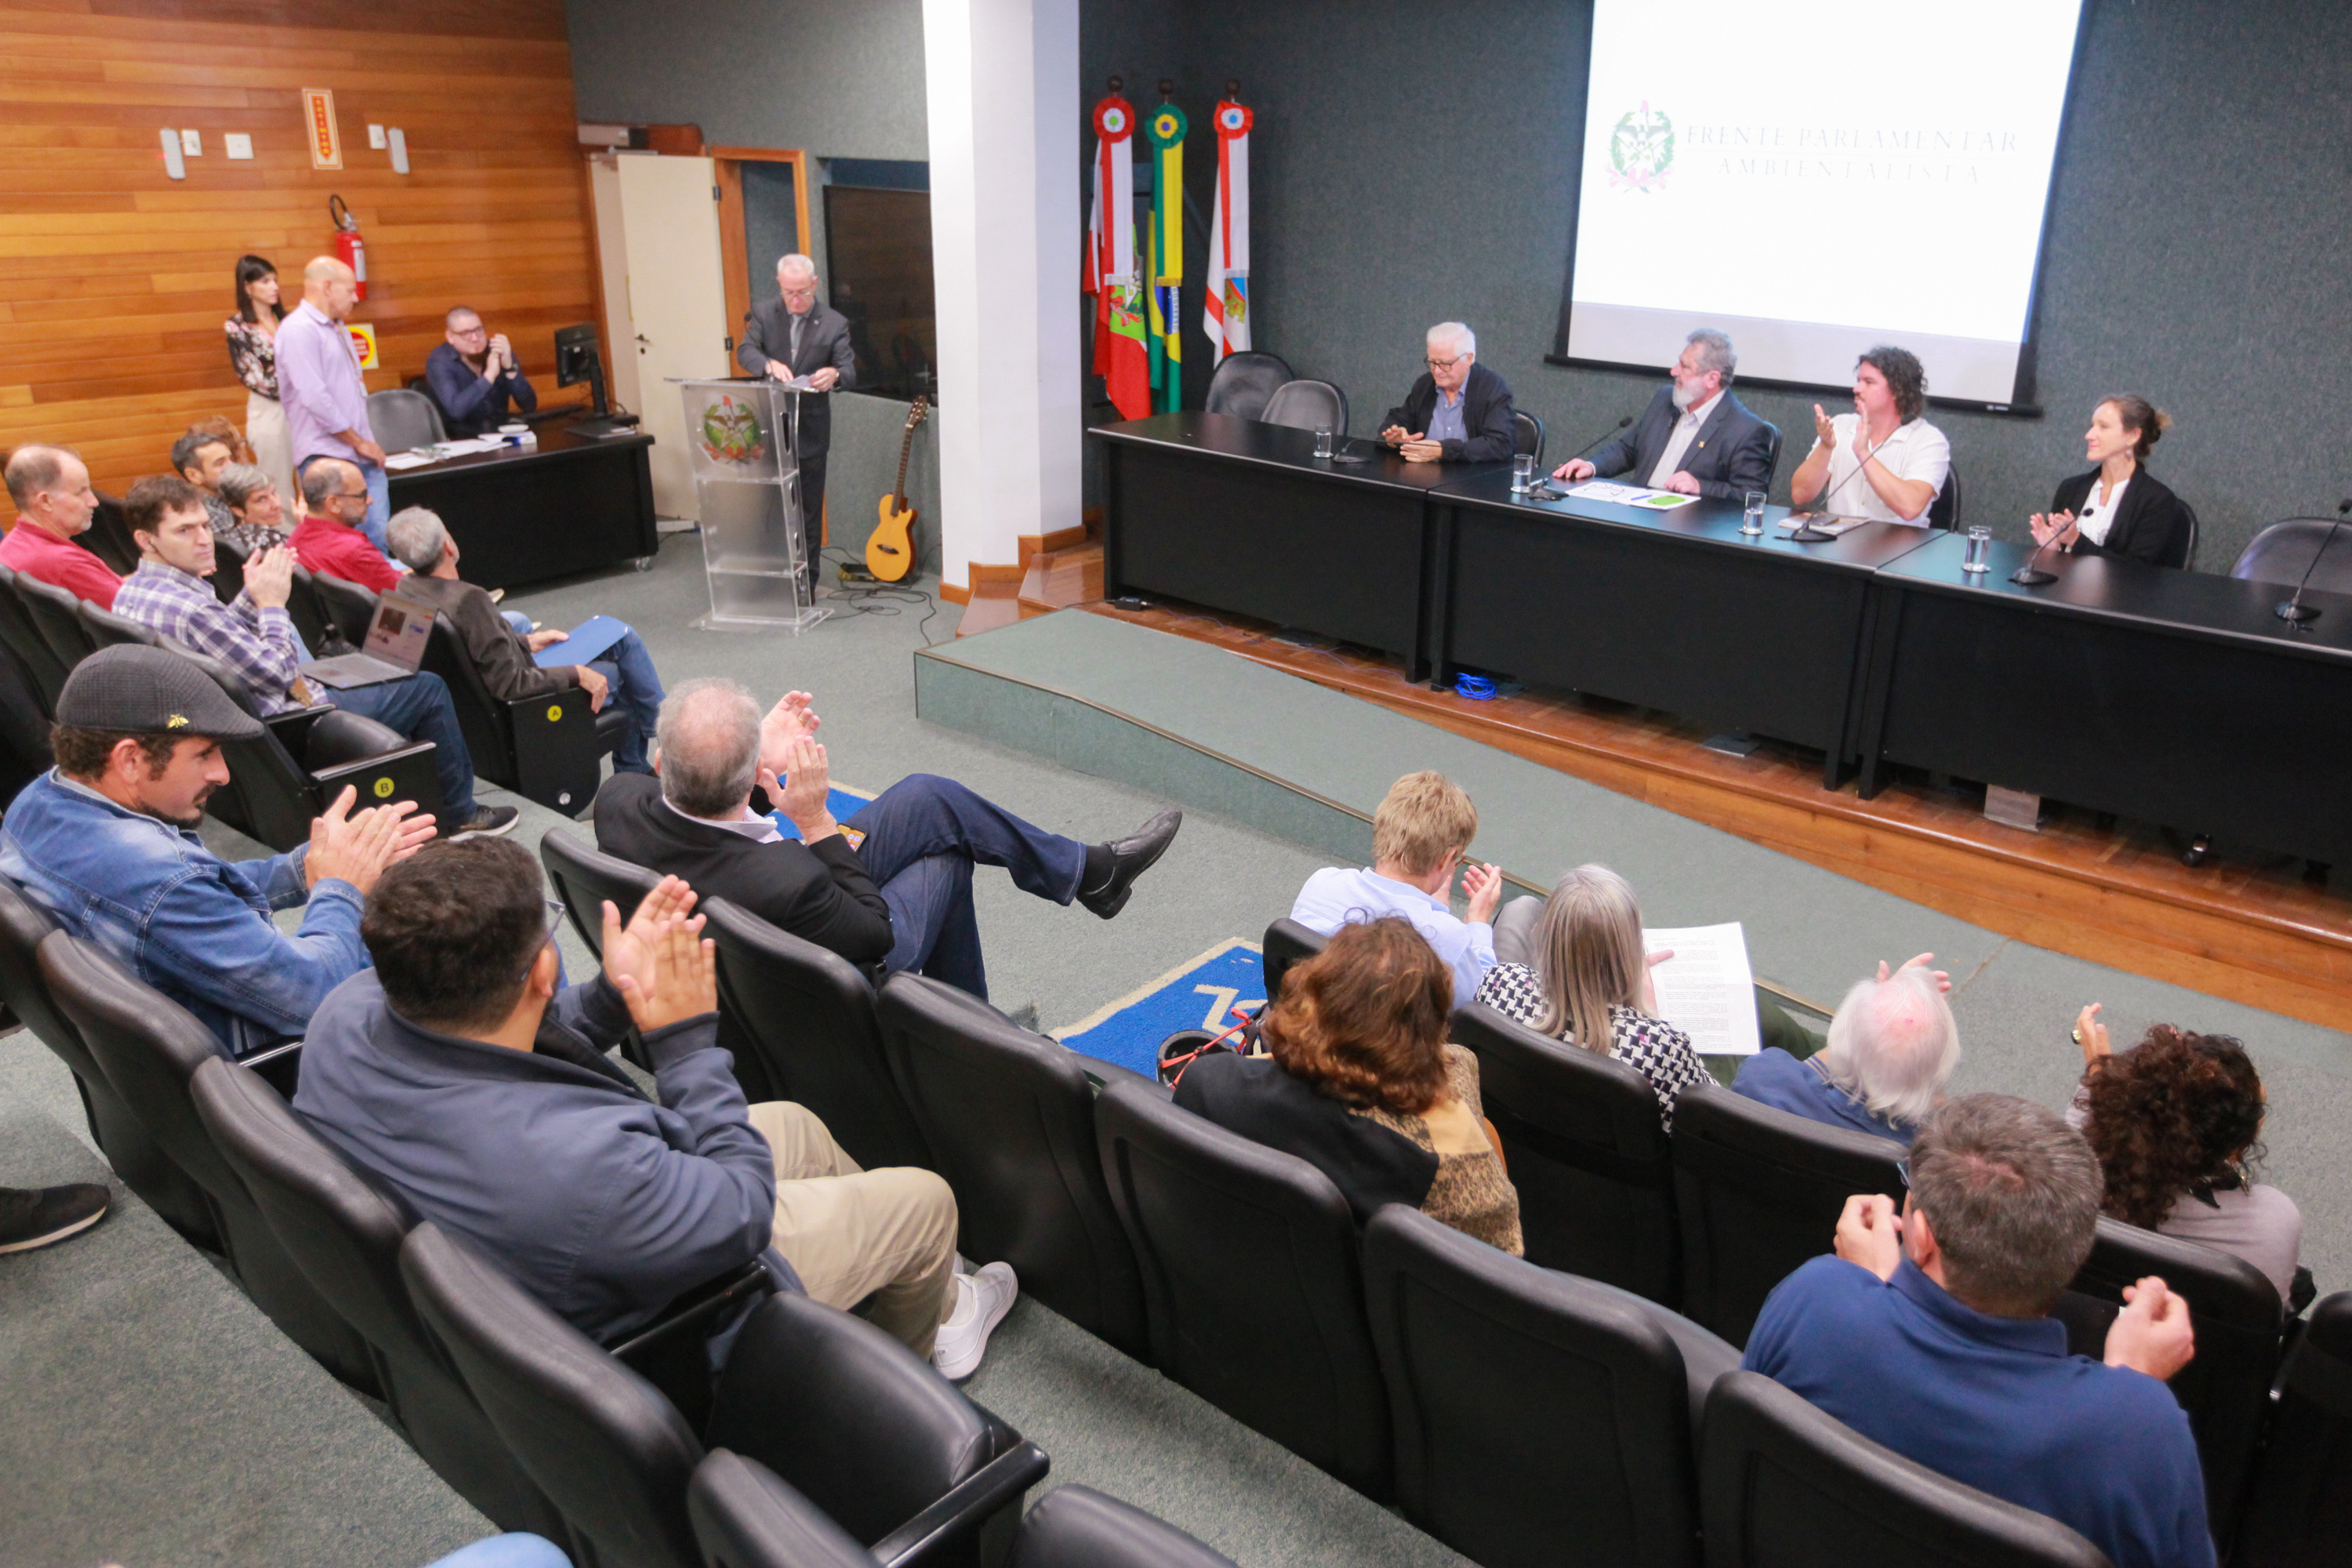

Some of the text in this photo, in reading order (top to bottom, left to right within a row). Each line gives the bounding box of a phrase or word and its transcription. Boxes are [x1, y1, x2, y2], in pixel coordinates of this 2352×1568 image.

[1687, 125, 2017, 152] FRENTE PARLAMENTAR
[1719, 157, 1979, 183] AMBIENTALISTA
[380, 782, 390, 793] B
